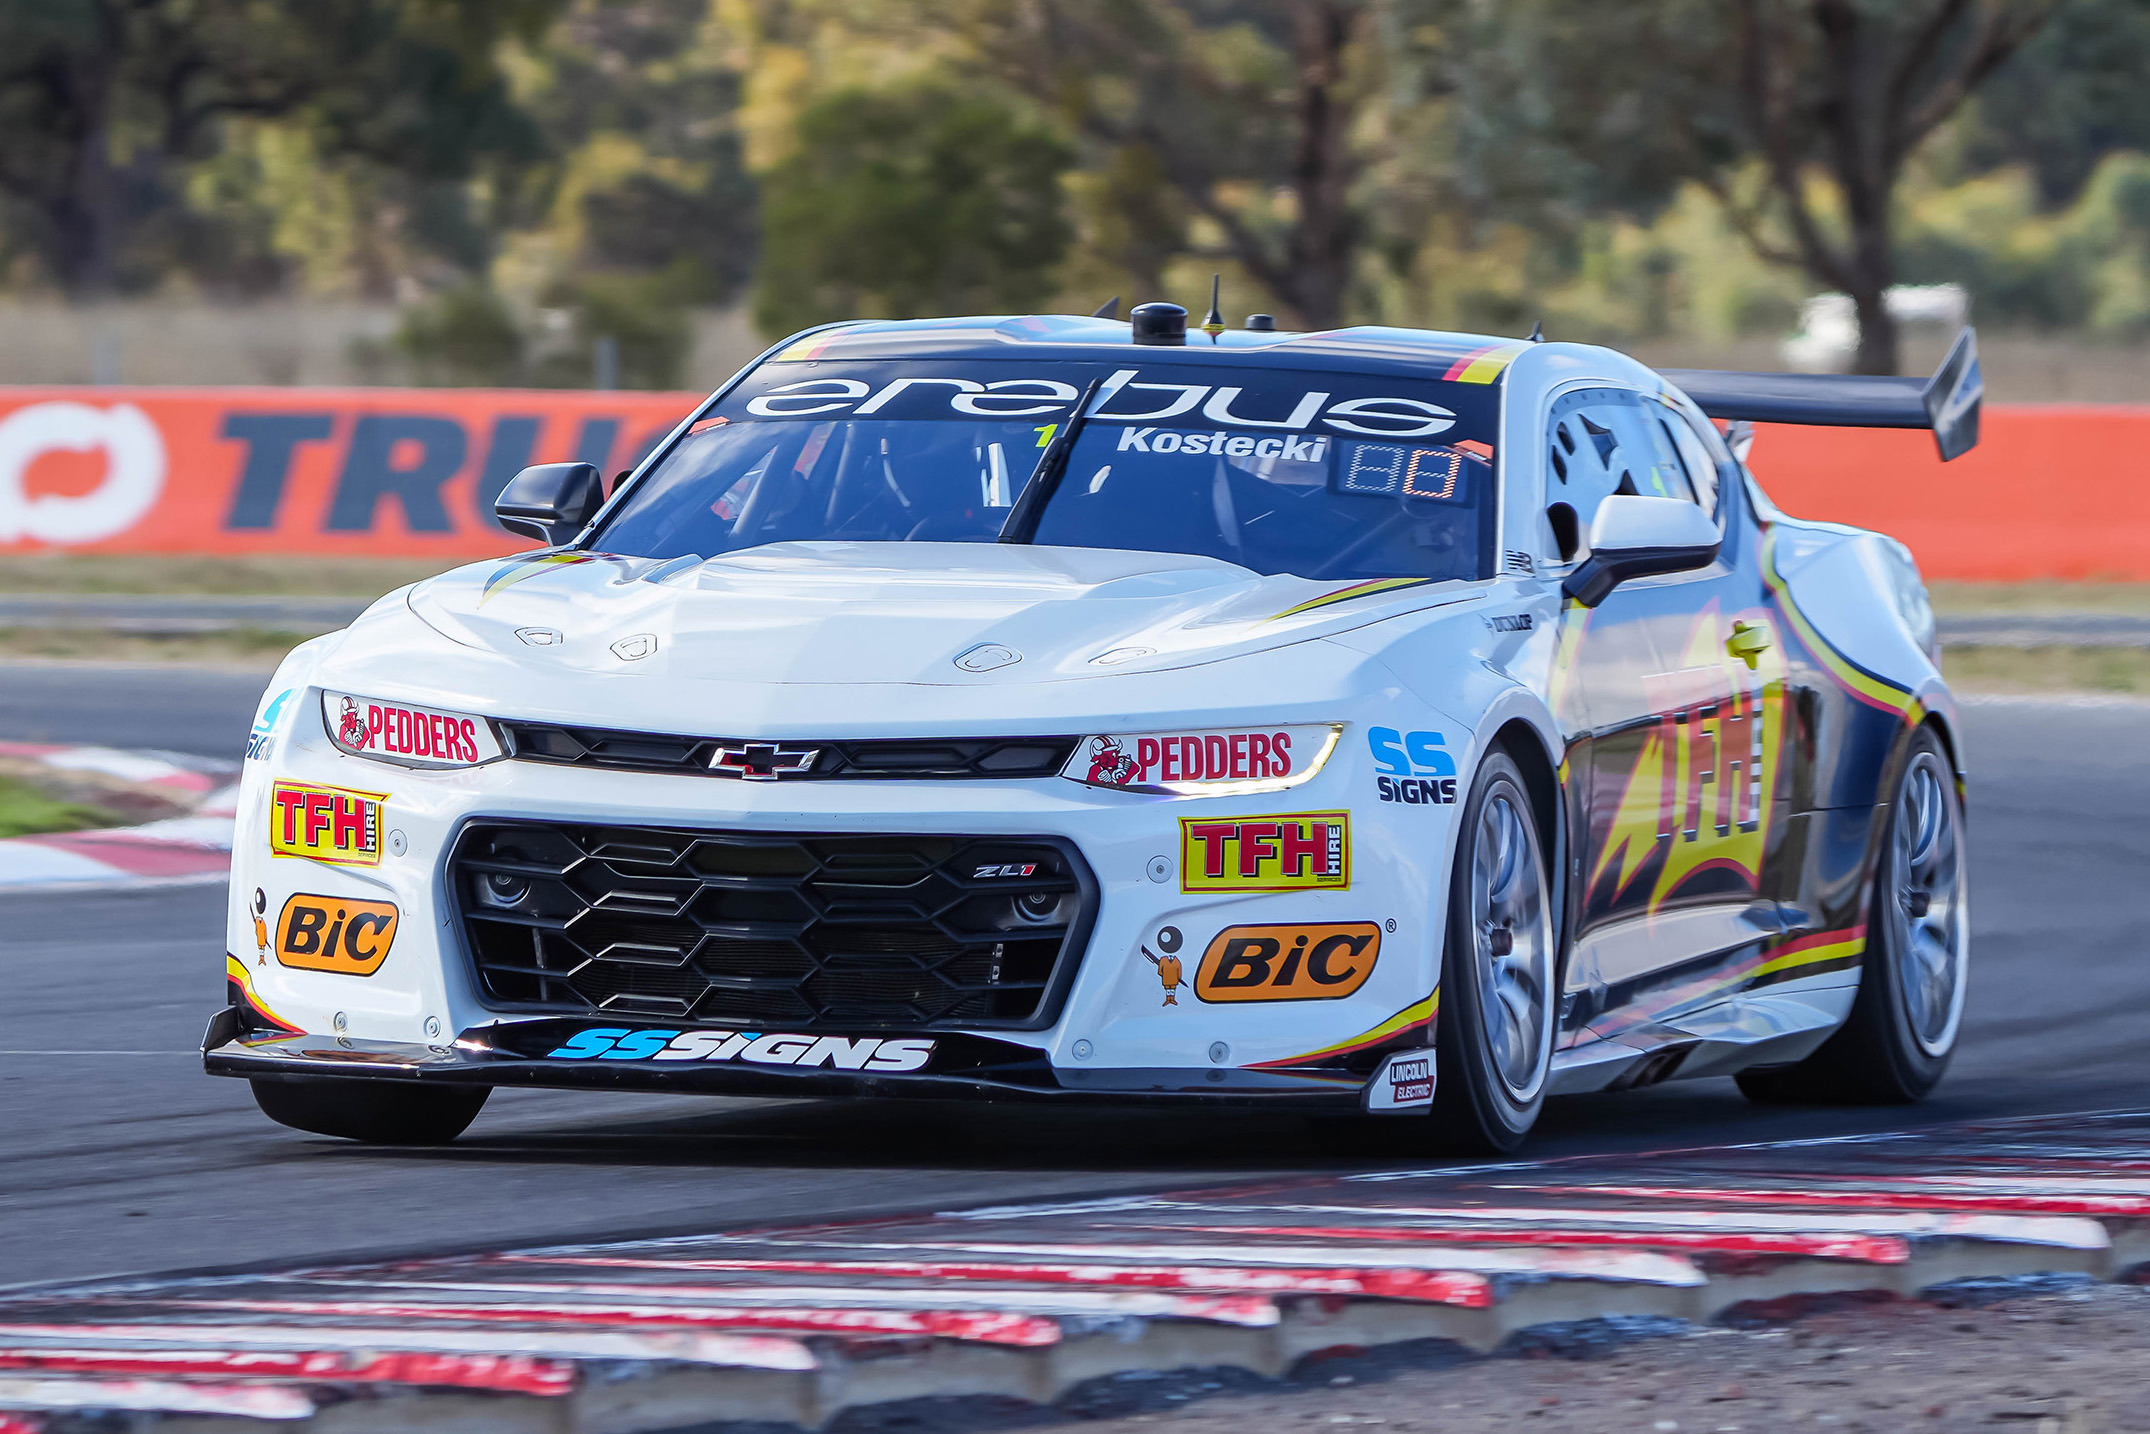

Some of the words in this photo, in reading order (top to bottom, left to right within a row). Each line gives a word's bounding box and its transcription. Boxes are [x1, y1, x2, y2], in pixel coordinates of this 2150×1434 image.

[746, 369, 1457, 437] erebus
[1034, 424, 1058, 447] 1
[1117, 426, 1328, 463] Kostecki
[368, 704, 478, 763] PEDDERS
[1368, 726, 1456, 777] SS
[1137, 732, 1291, 782] PEDDERS
[1377, 776, 1457, 805] SIGNS
[277, 789, 367, 851] TFH
[366, 802, 375, 850] HIRE
[1190, 821, 1330, 877] TFH
[1328, 826, 1340, 874] HIRE
[973, 864, 1037, 878] ZL1
[1391, 1062, 1428, 1083] LINCOLN
[1397, 1083, 1431, 1099] ELECTRIC
